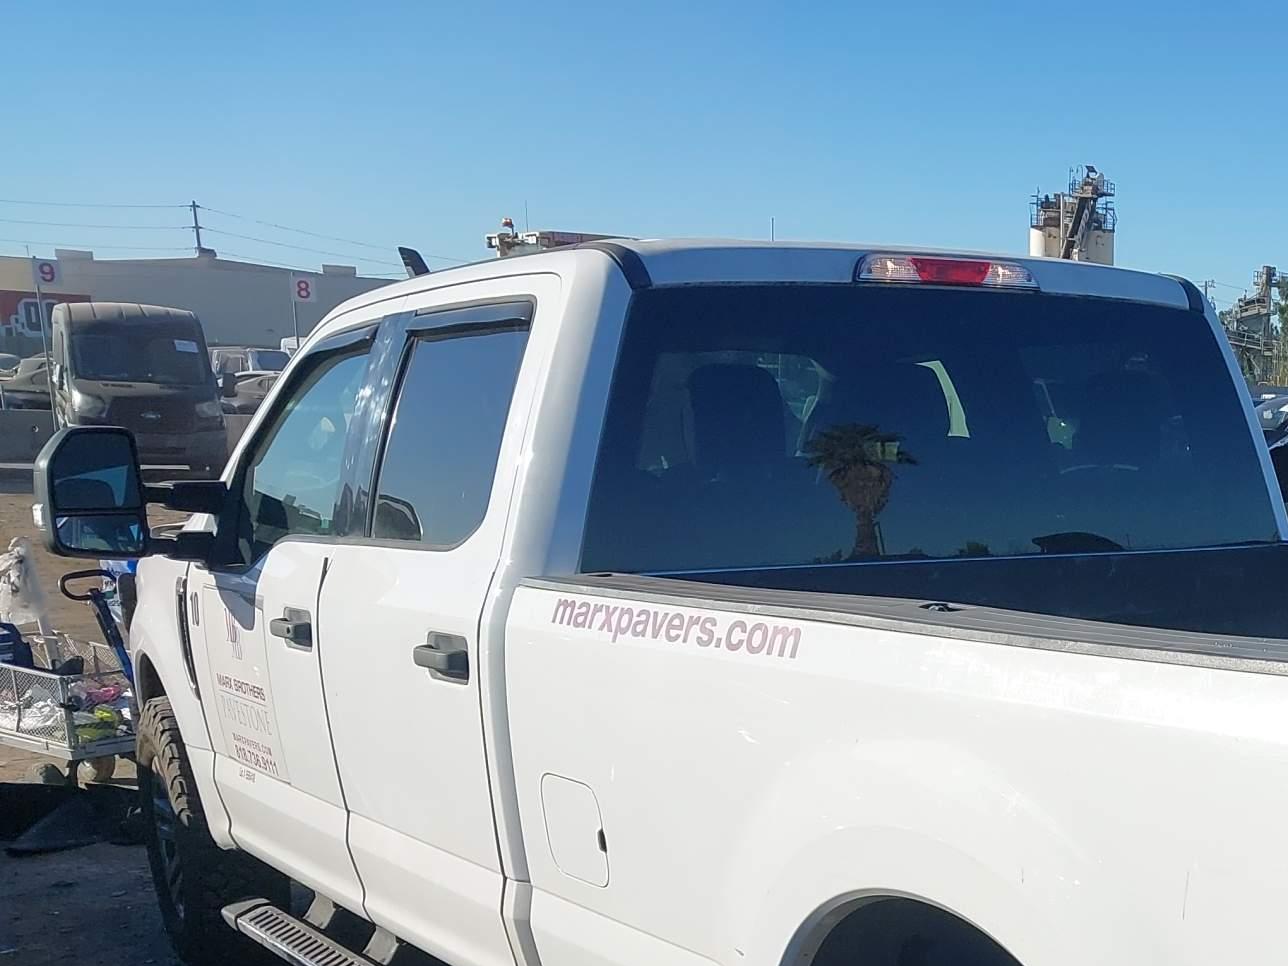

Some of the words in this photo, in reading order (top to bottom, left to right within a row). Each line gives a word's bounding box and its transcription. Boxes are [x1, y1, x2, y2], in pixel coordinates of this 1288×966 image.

[39, 263, 55, 282] 9
[297, 280, 311, 299] 8
[190, 591, 200, 627] 10
[551, 598, 802, 659] marxpavers.com
[216, 673, 233, 691] MARX
[233, 679, 266, 702] BROTHERS
